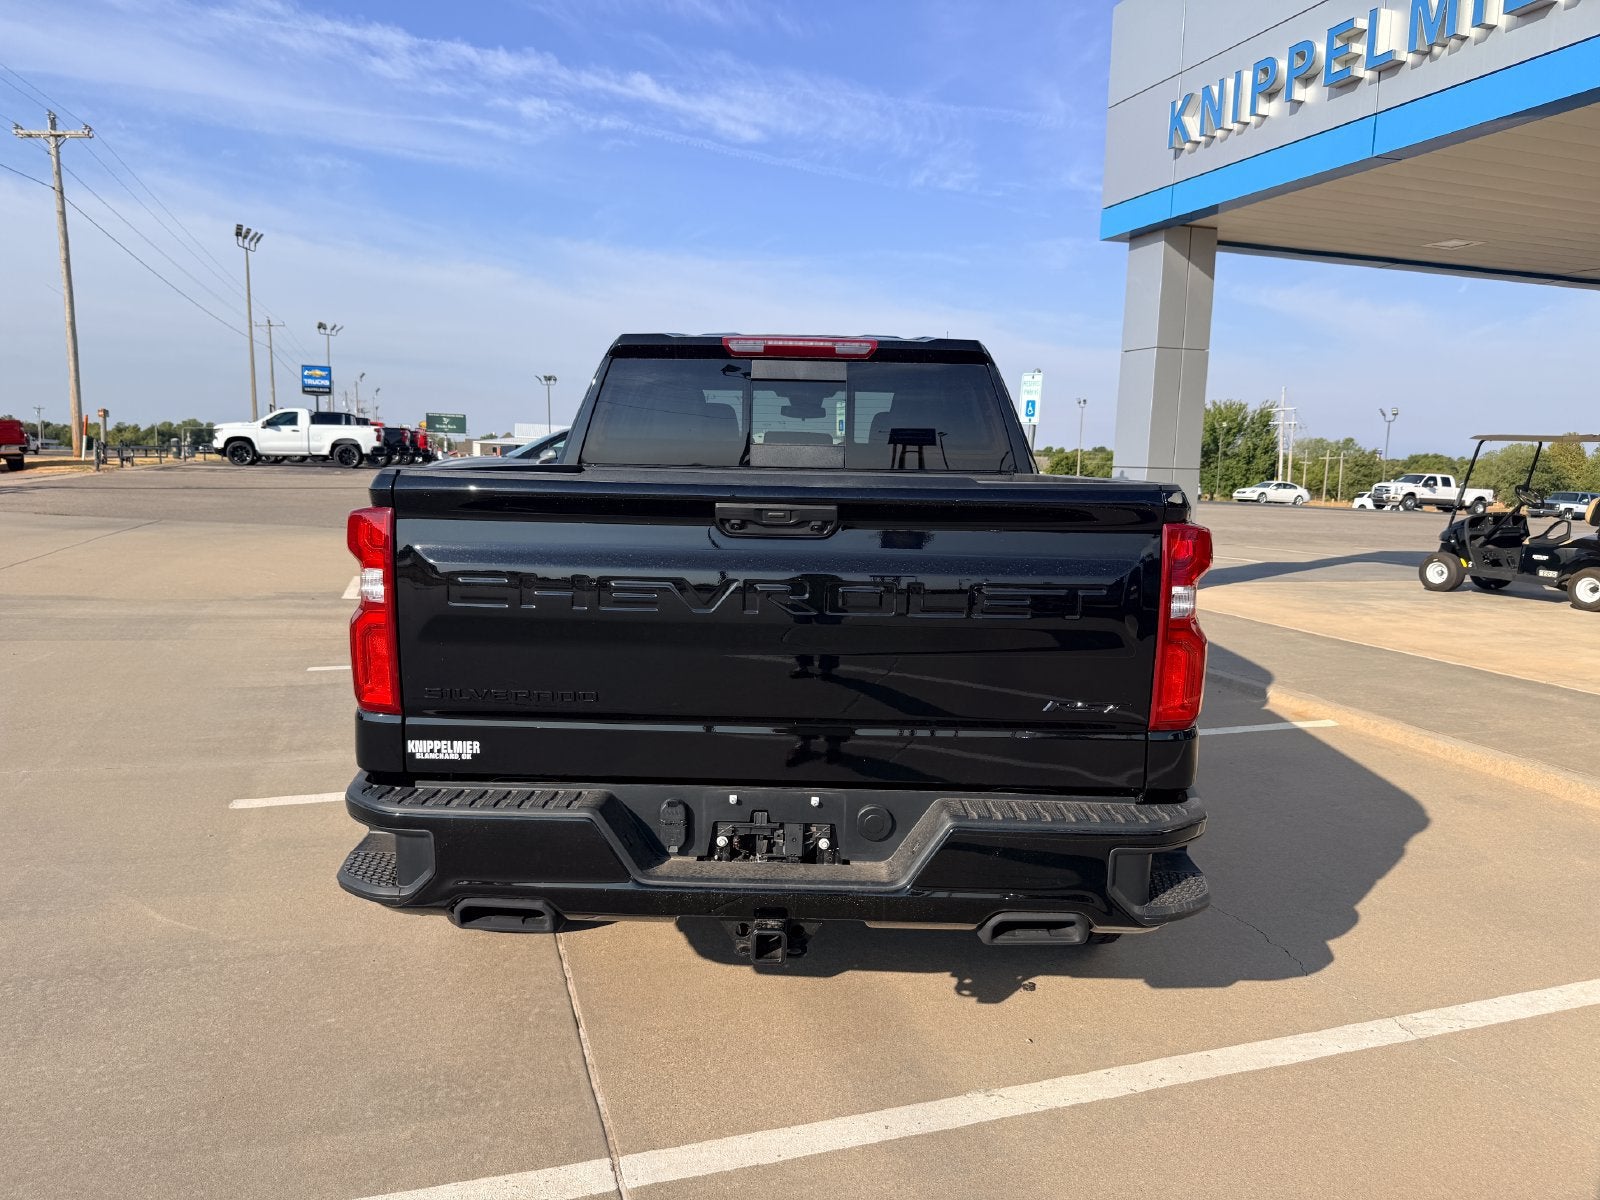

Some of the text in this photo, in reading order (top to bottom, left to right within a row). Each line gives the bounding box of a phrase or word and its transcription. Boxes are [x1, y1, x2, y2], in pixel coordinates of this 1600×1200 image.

[1168, 0, 1558, 150] KNIPPELM
[303, 378, 330, 386] TRUCKS
[447, 571, 1109, 620] CHEVROLET
[423, 687, 601, 703] SILVERADO
[407, 740, 481, 754] KNIPPELMIER
[415, 753, 461, 761] BLANCHARD,
